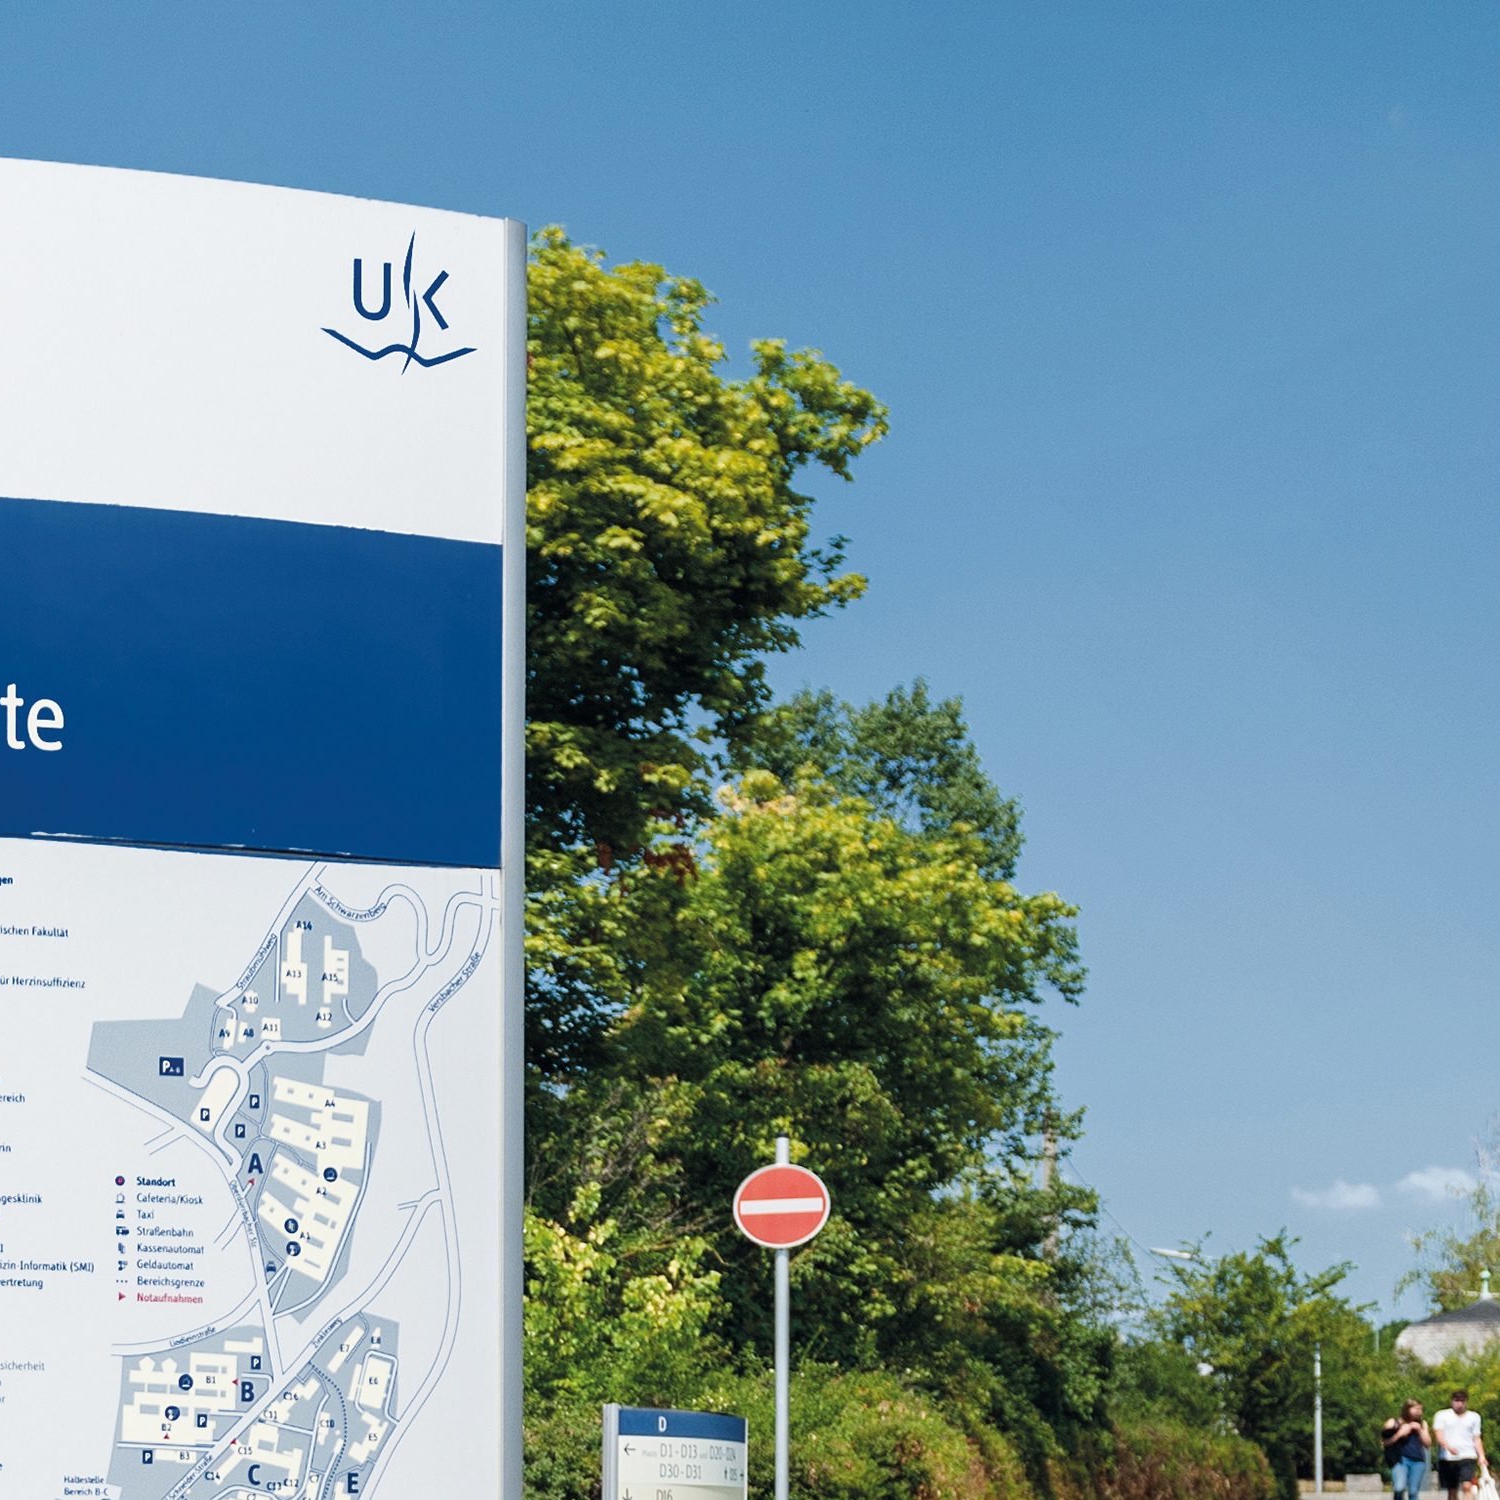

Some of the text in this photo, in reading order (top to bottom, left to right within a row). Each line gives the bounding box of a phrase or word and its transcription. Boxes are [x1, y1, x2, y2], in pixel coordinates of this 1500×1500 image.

[296, 921, 313, 931] A14
[285, 969, 302, 978] A13
[248, 1152, 263, 1174] A
[136, 1176, 175, 1187] Standort
[136, 1193, 203, 1204] Cafeteria/Kiosk
[136, 1210, 154, 1219] Taxi
[136, 1226, 194, 1237] Straßenbahn
[136, 1243, 204, 1254] Kassenautomat
[136, 1259, 193, 1270] Geldautomat
[136, 1276, 205, 1289] Bereichsgrenze
[136, 1293, 203, 1303] Notaufnahmen
[240, 1381, 254, 1402] B
[658, 1416, 667, 1432] D
[248, 1464, 261, 1485] C
[347, 1472, 359, 1493] E
